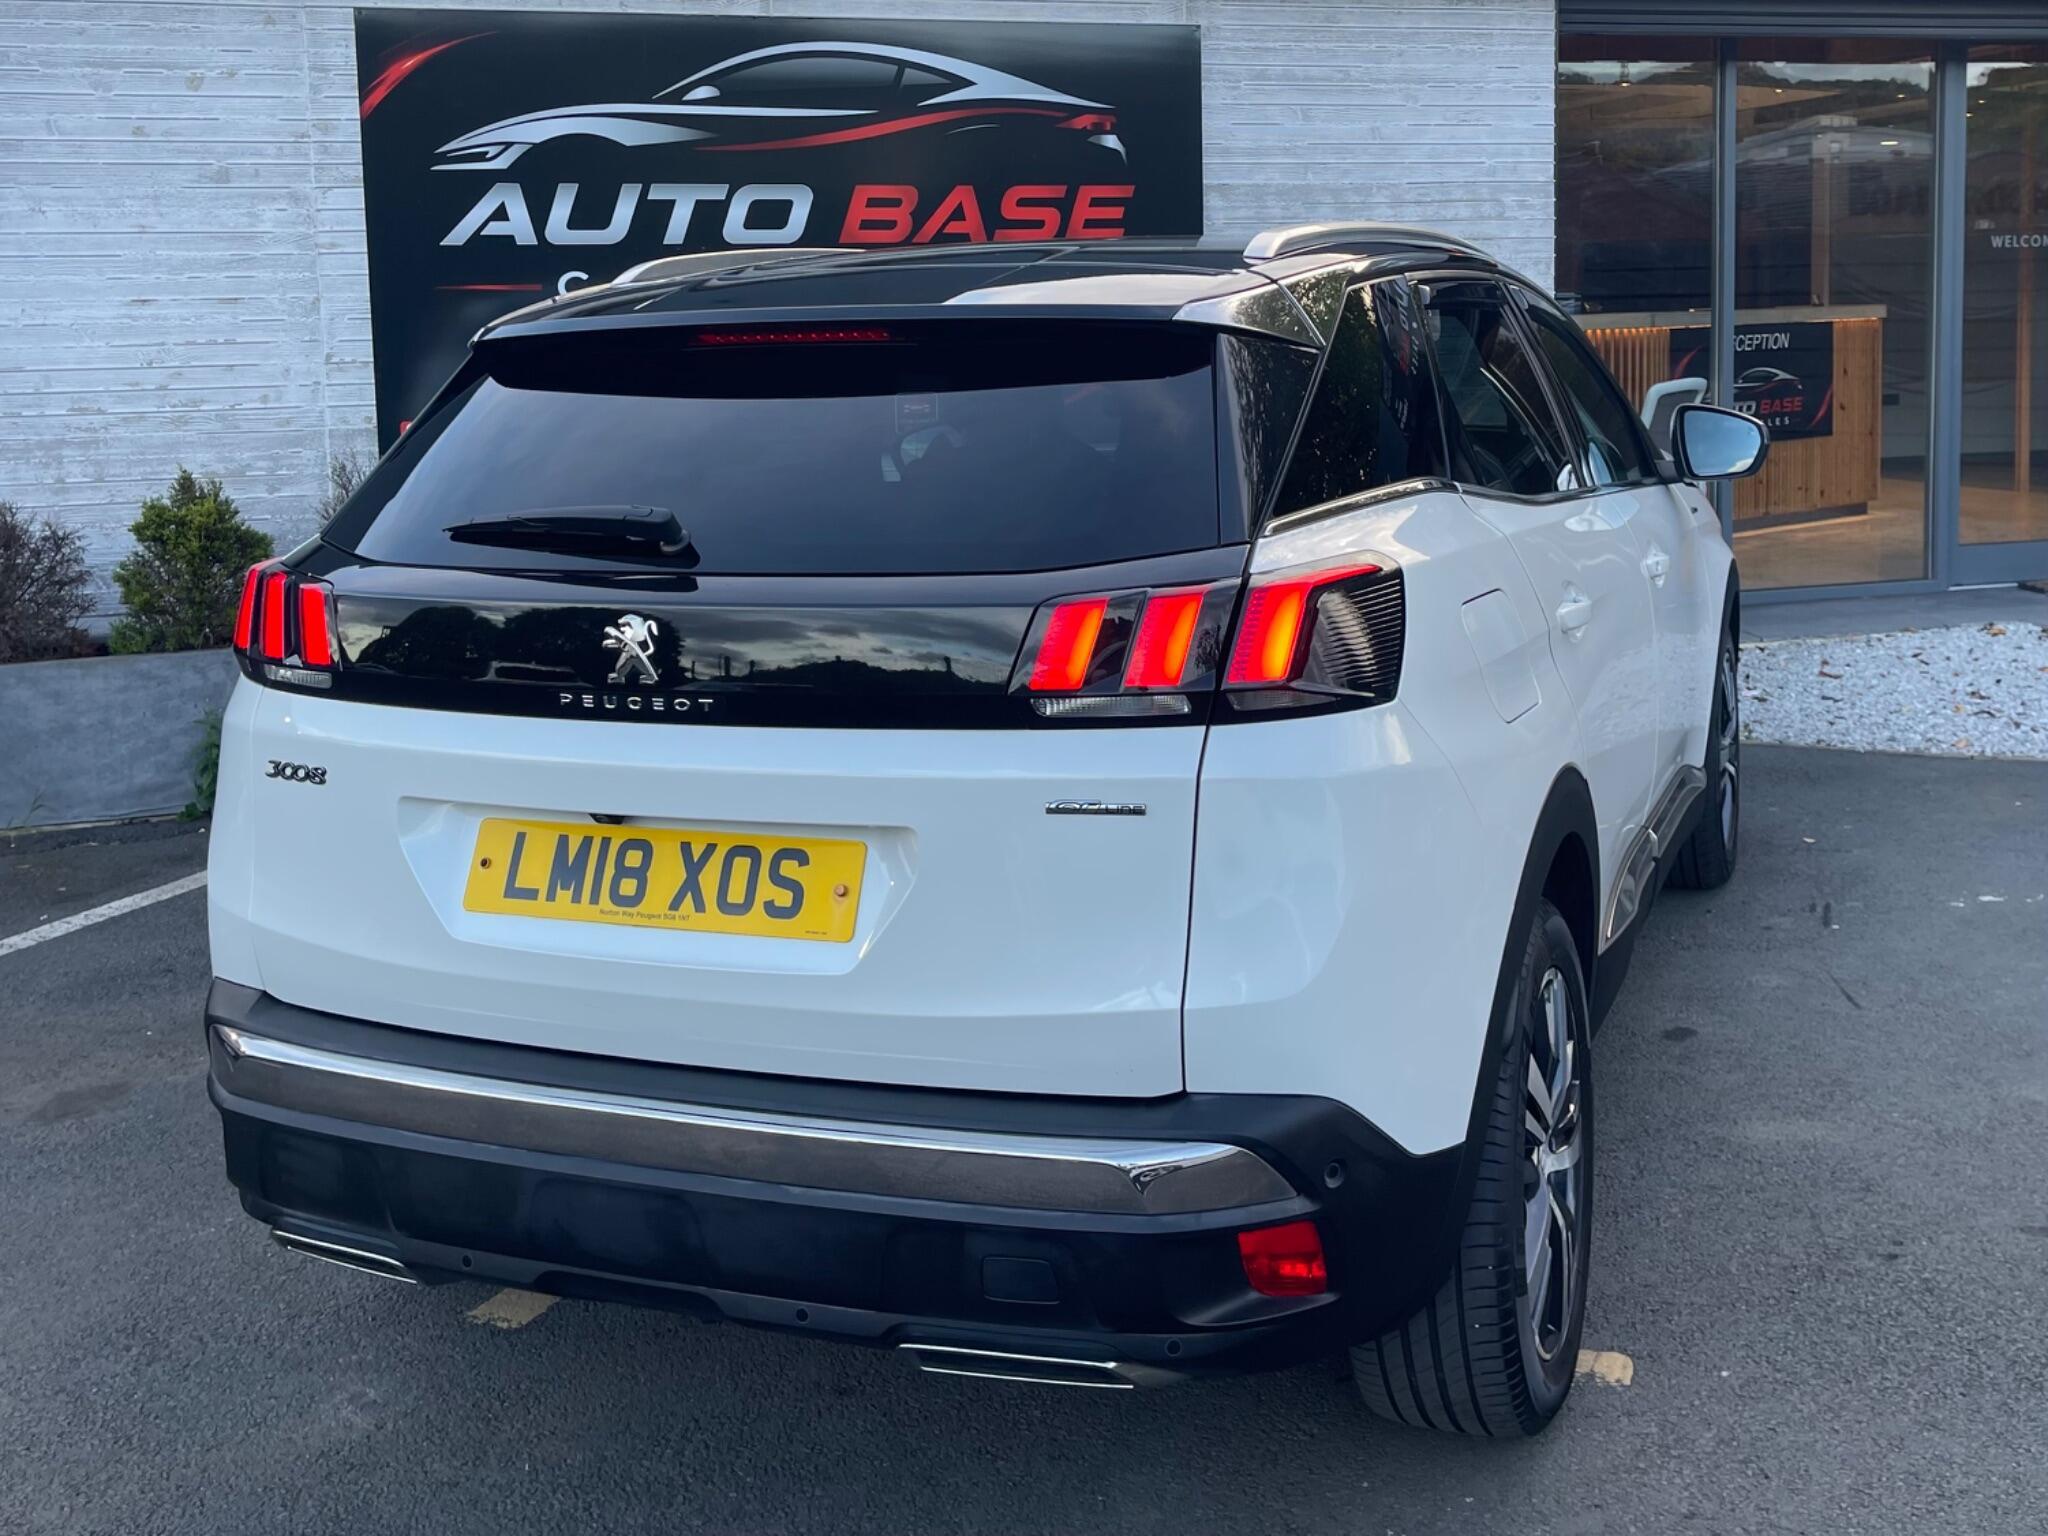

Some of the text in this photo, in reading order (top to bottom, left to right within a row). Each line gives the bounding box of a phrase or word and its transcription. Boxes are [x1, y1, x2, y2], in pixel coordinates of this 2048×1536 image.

[439, 182, 1136, 246] AUTO BASE
[1732, 332, 1791, 352] CEPTION
[1734, 396, 1804, 415] TO BASE
[1766, 416, 1790, 426] LES
[559, 692, 714, 712] PEUGEOT
[265, 759, 328, 785] 3008
[502, 831, 810, 920] LM18 XOS
